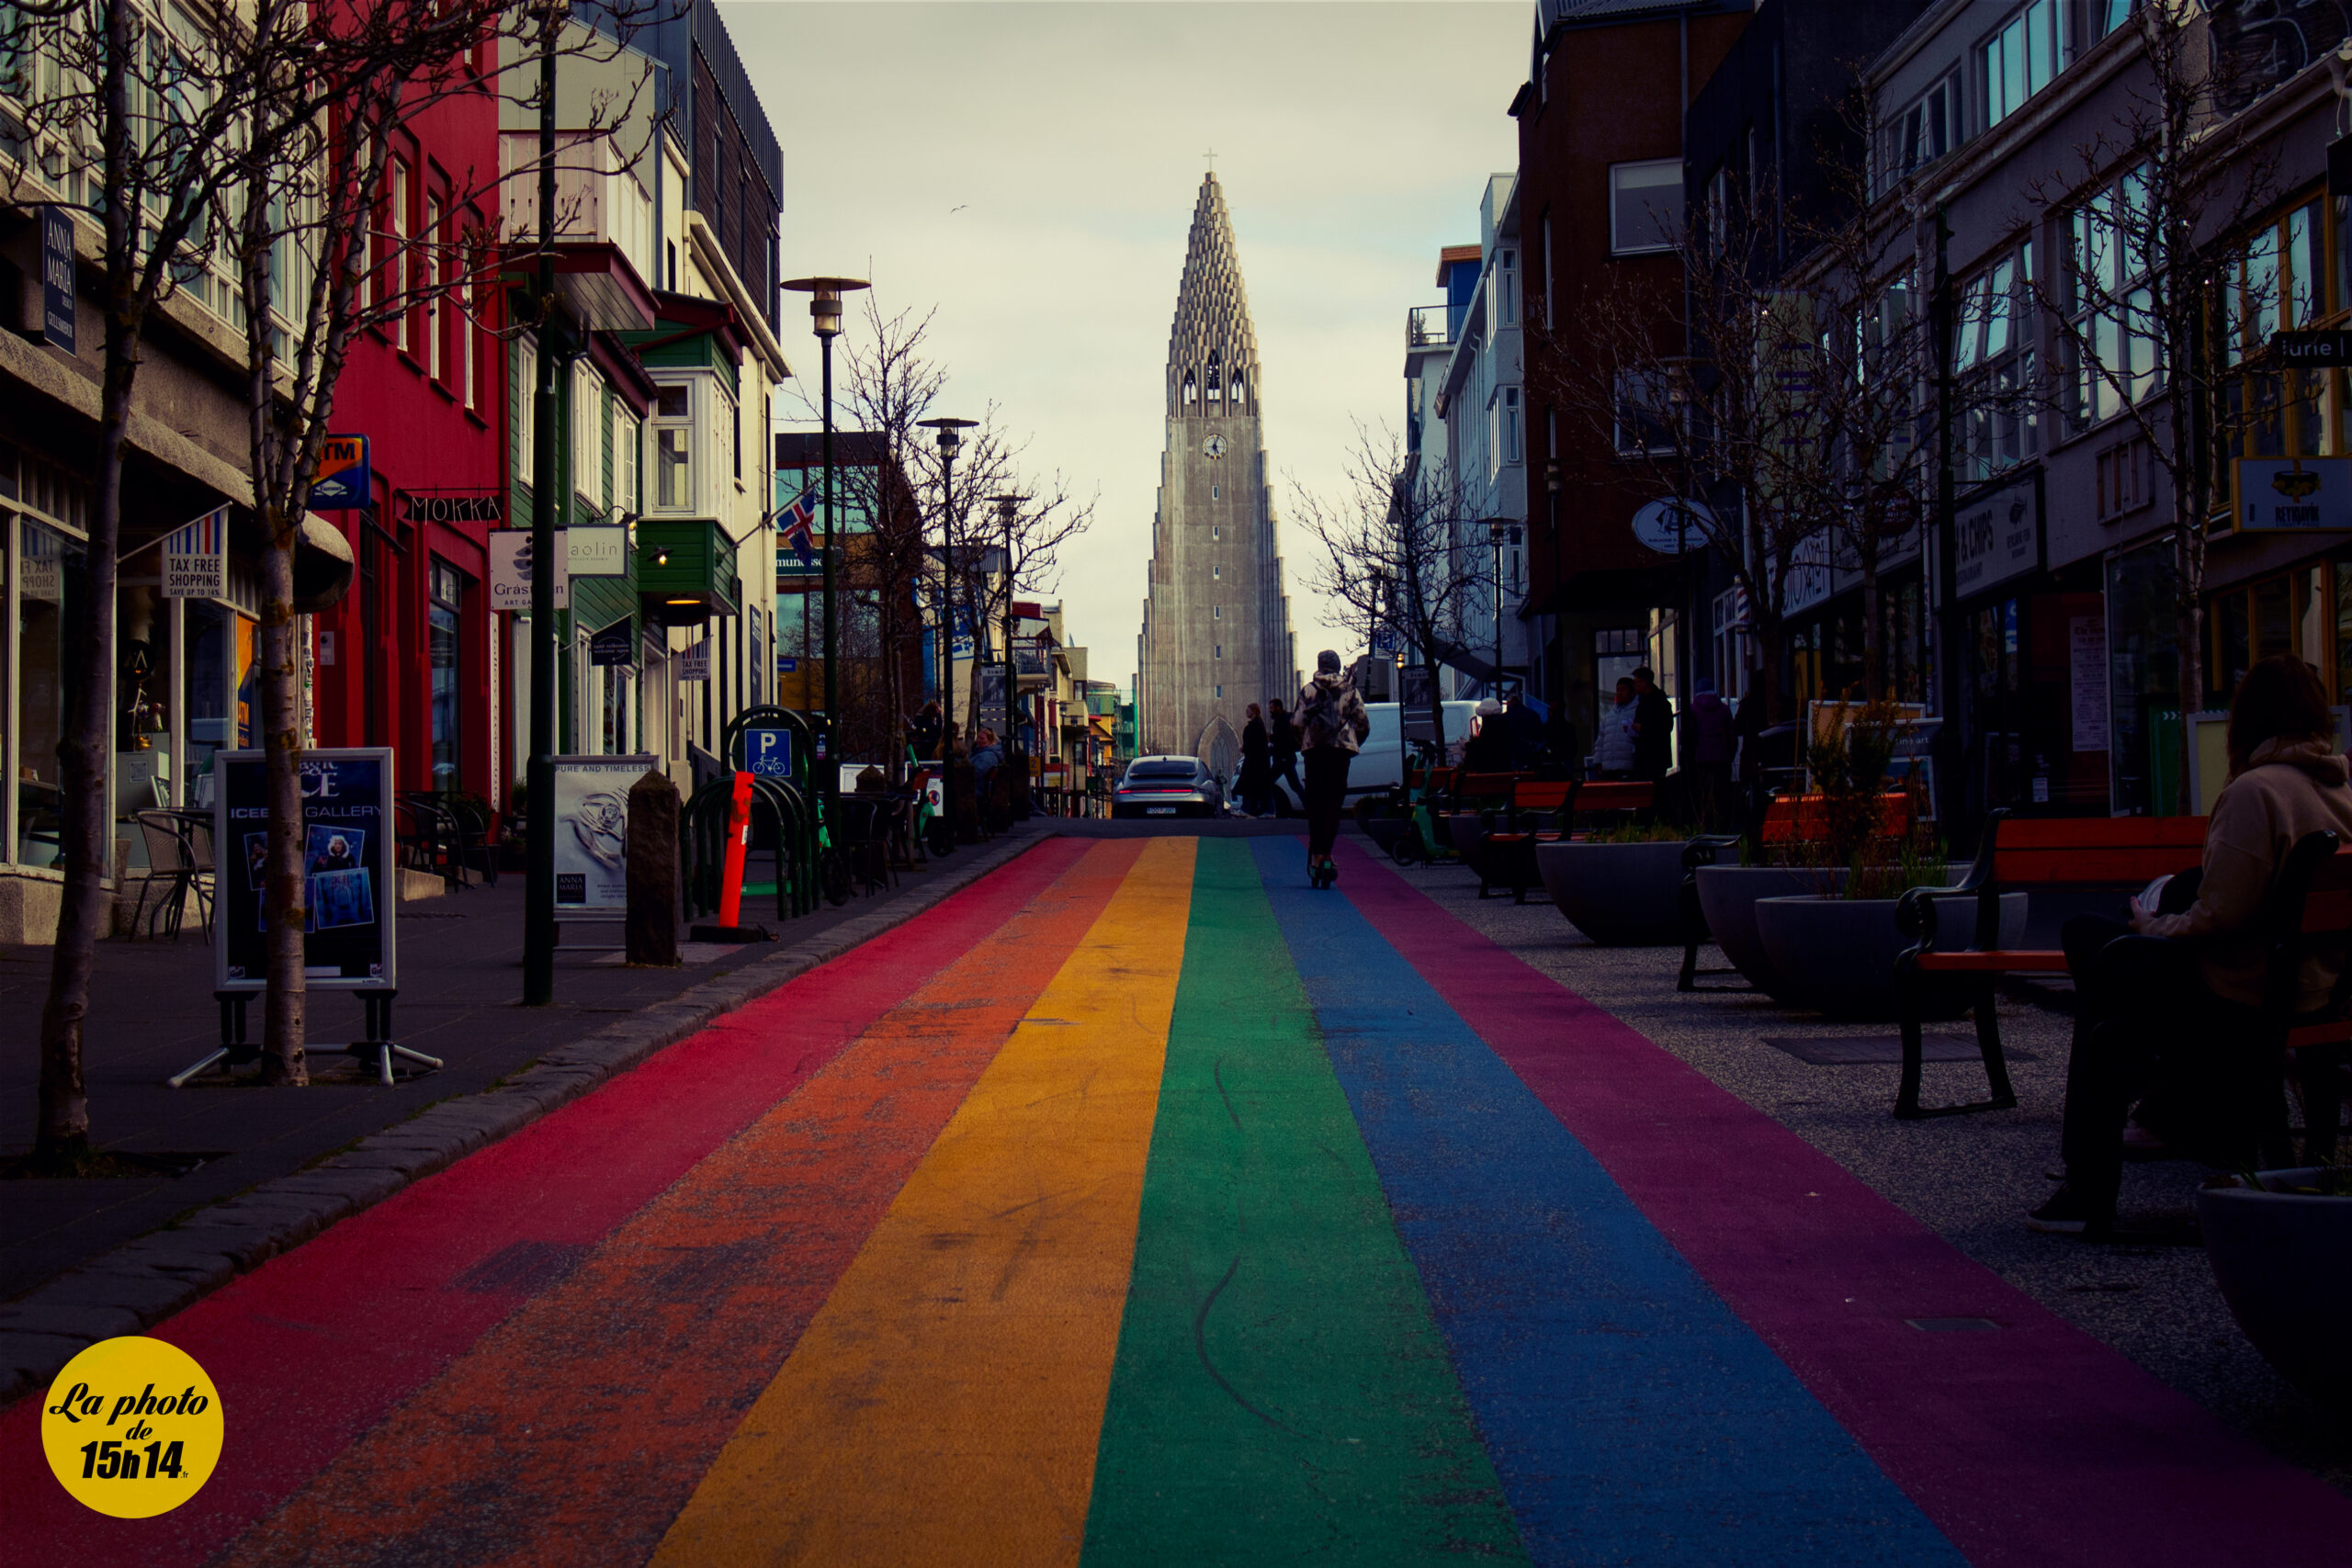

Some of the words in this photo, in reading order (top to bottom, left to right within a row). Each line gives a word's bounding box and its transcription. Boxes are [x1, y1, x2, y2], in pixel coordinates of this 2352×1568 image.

[48, 219, 72, 261] ANNA
[48, 253, 73, 296] MARÍA
[323, 442, 355, 459] TM
[412, 496, 501, 525] MOKKA
[1969, 509, 1994, 558] CHIPS
[571, 541, 617, 555] aolin
[170, 558, 189, 571] TAX
[194, 558, 220, 572] FREE
[169, 574, 220, 587] SHOPPING
[494, 582, 564, 595] Grásn
[760, 732, 777, 754] P
[305, 806, 381, 818] GALLERY
